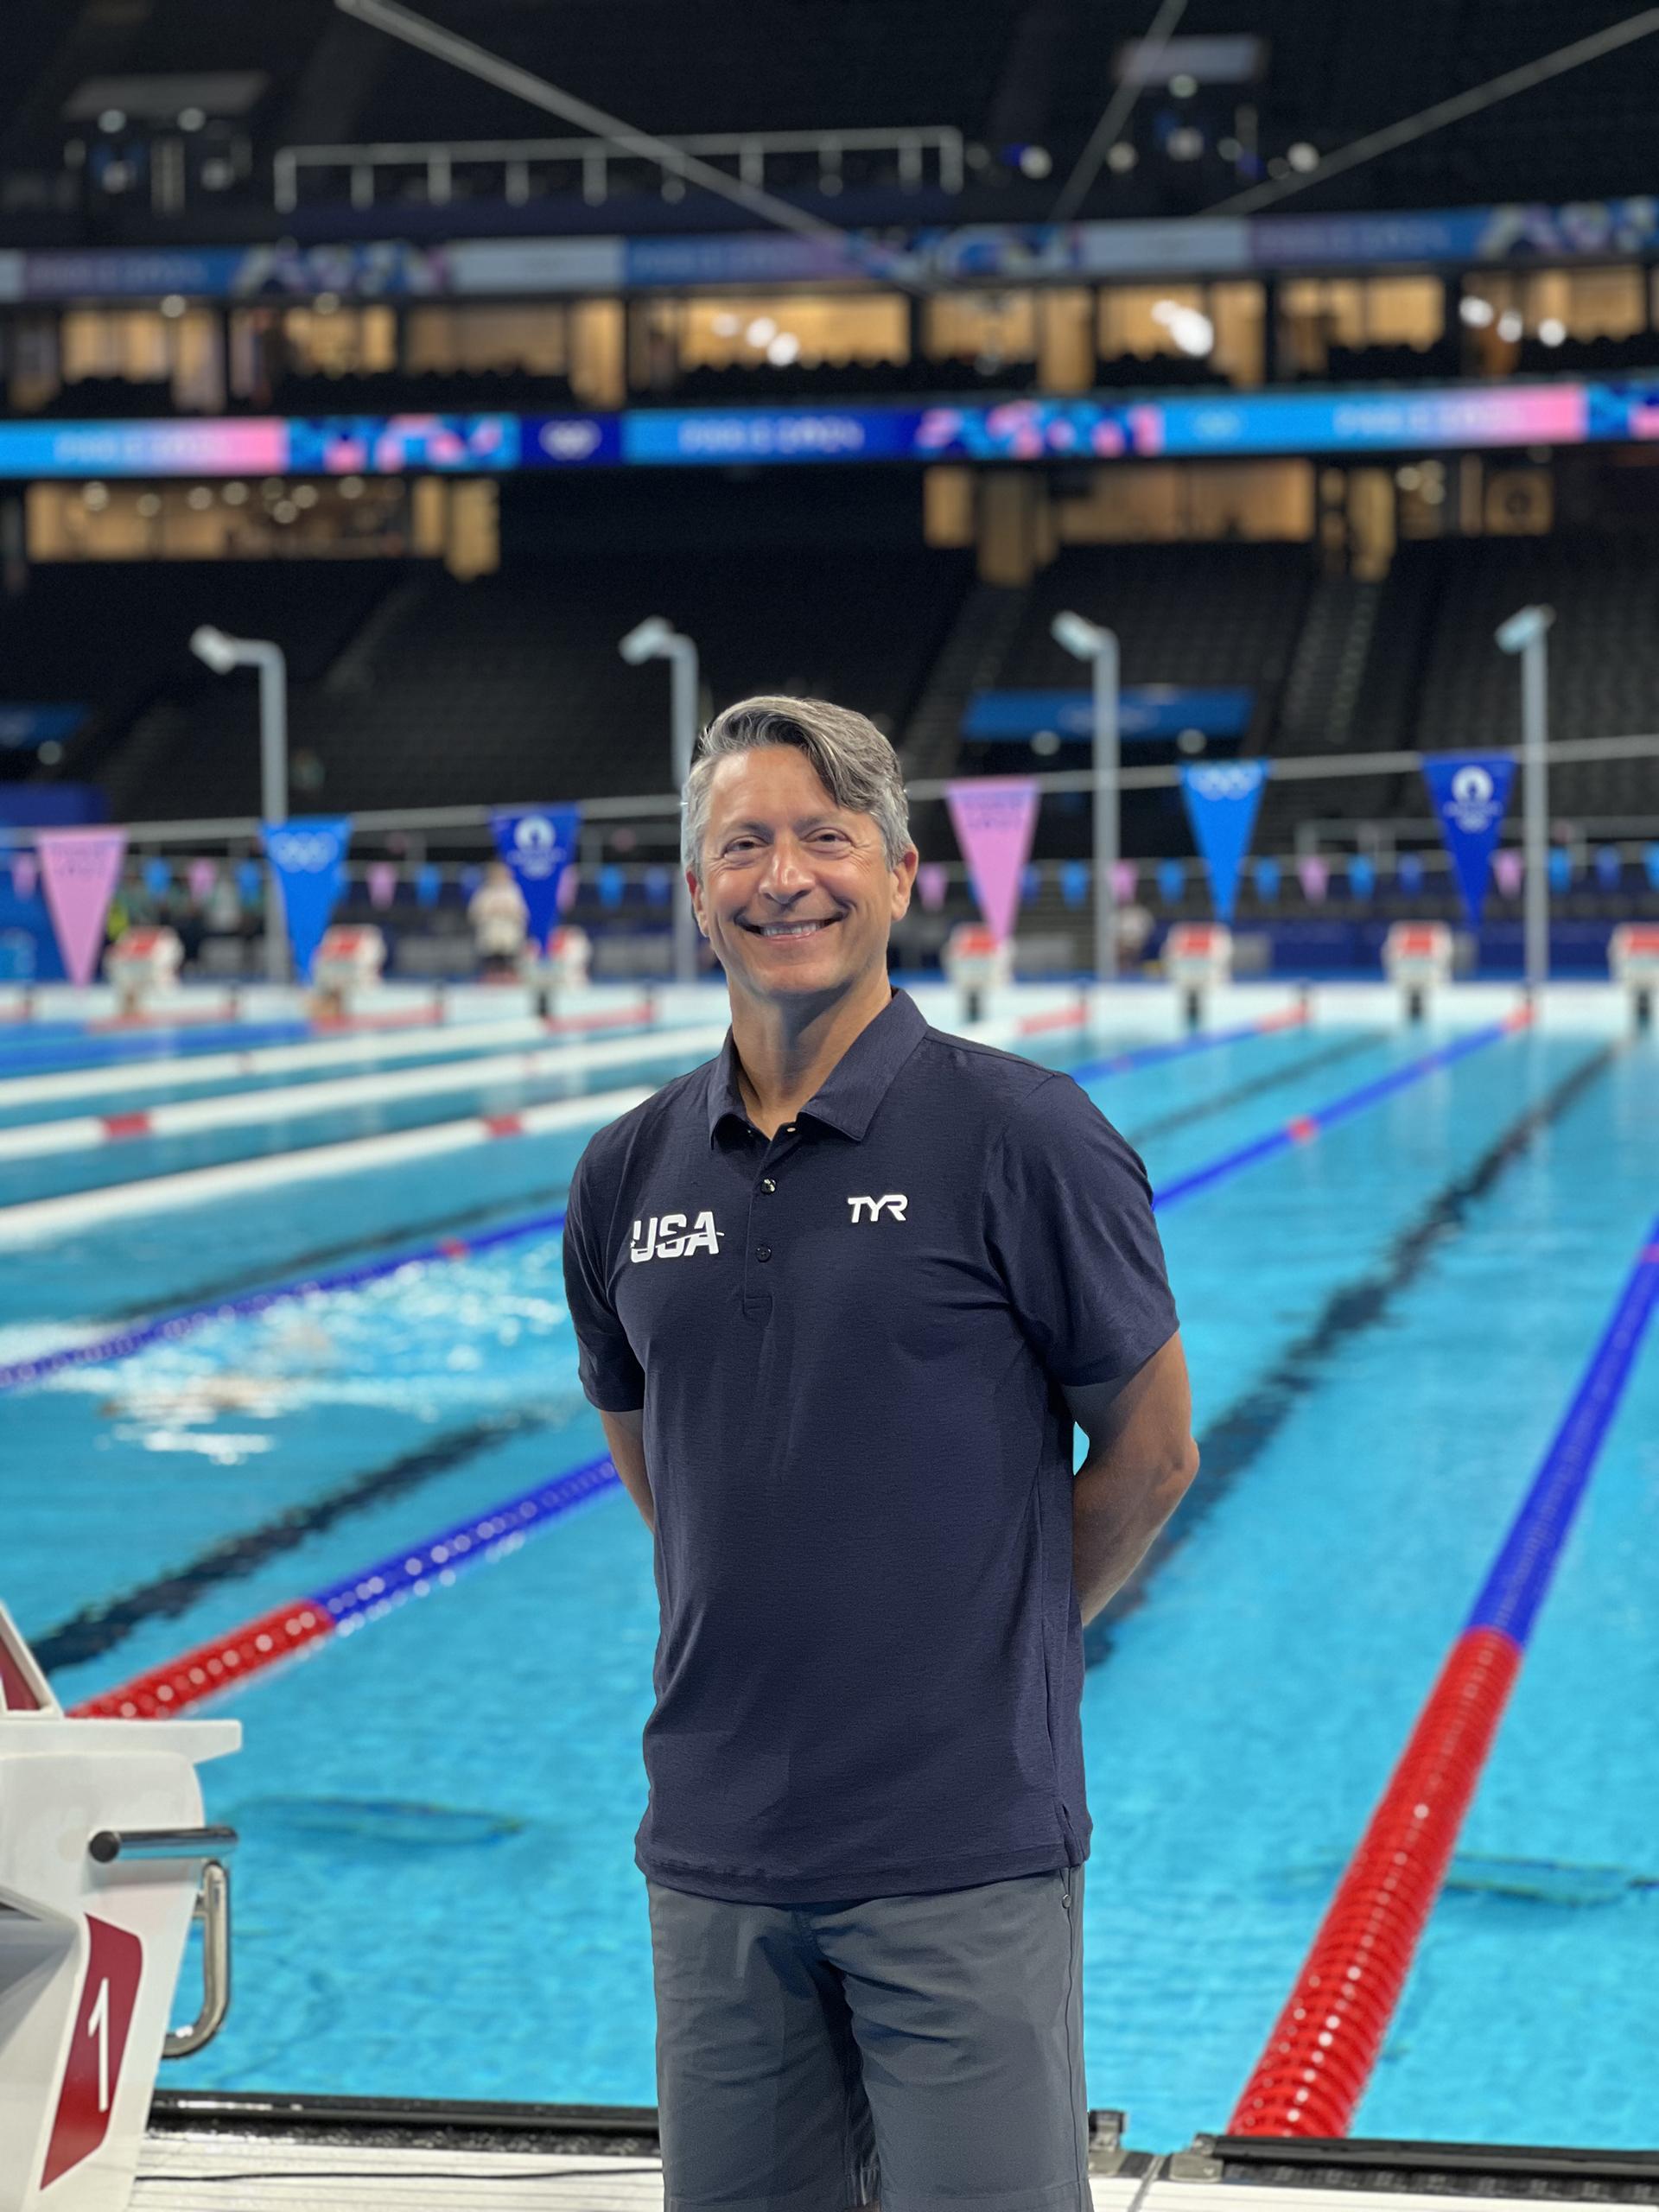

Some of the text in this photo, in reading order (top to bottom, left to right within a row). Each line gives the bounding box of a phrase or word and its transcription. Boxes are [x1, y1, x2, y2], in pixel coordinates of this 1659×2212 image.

[848, 1194, 908, 1224] TYR
[631, 1211, 724, 1262] USA
[88, 1978, 109, 2113] 1
